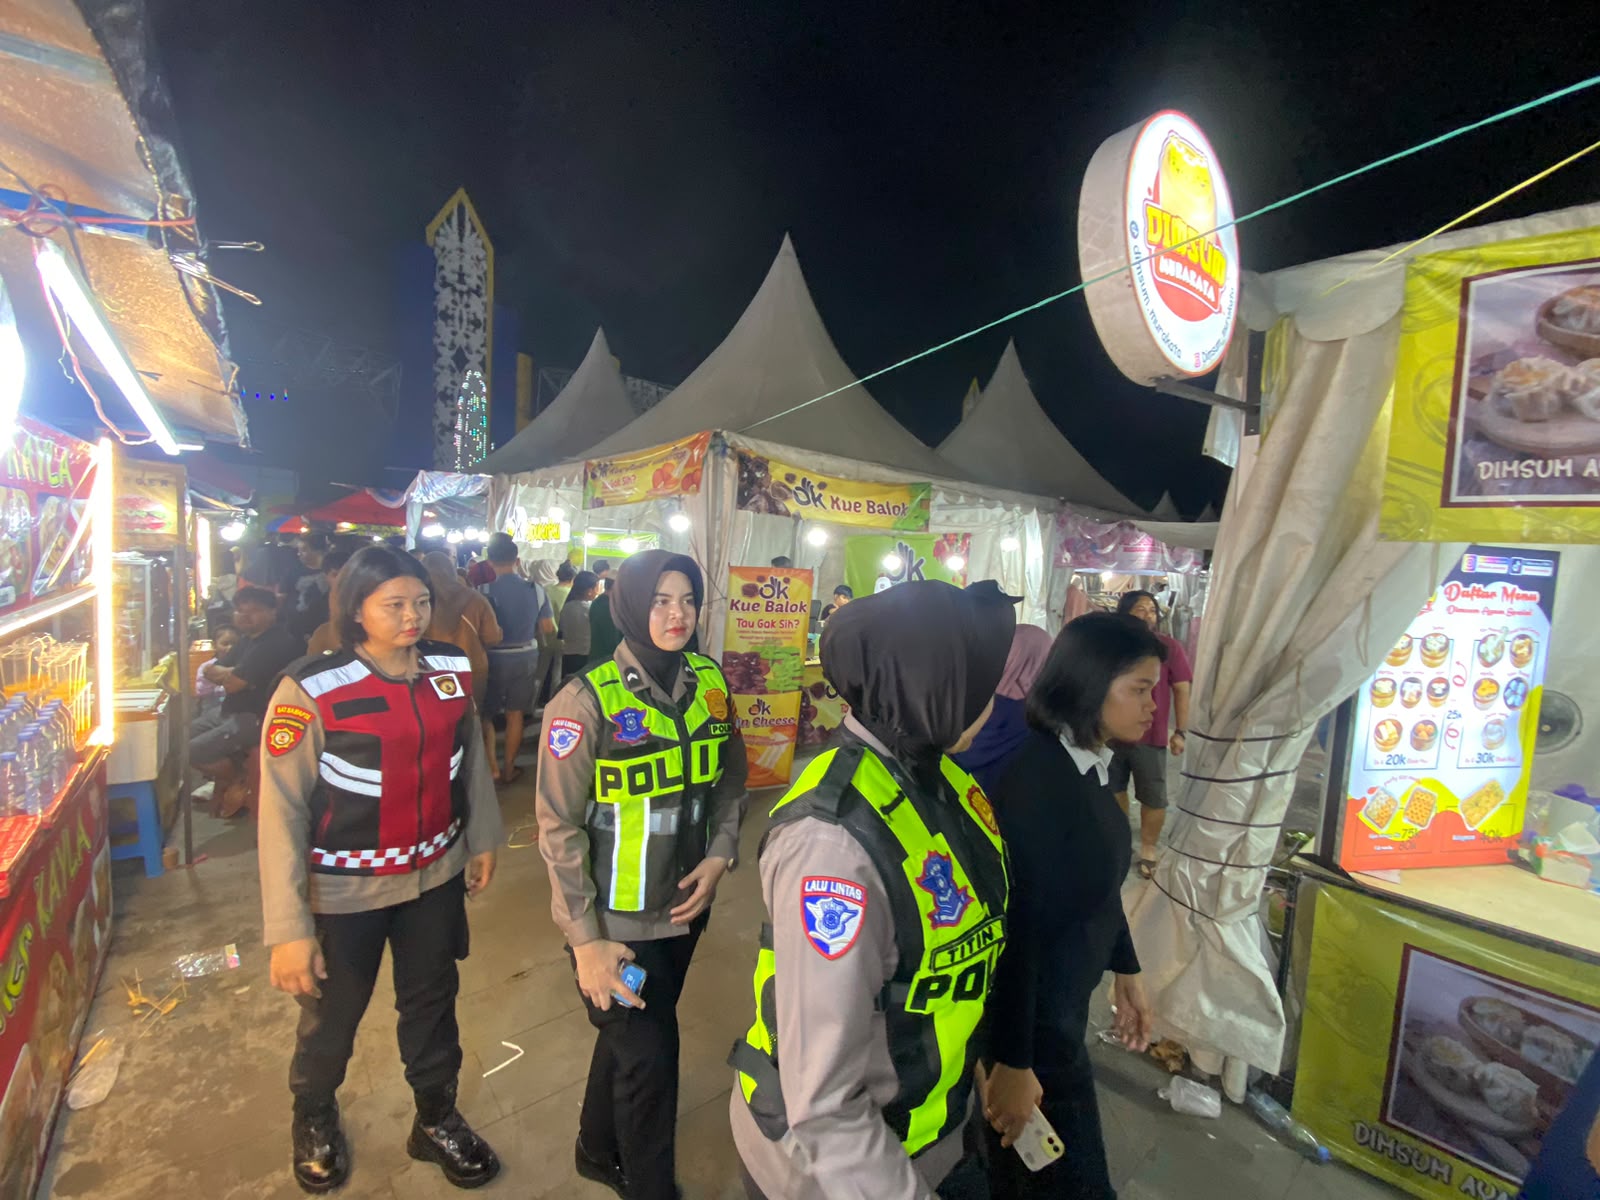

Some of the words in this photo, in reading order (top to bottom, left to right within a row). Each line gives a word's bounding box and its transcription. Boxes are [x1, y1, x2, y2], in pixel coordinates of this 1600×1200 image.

[1146, 205, 1227, 288] DIMSUM
[1478, 459, 1573, 479] DIMSUM
[1583, 458, 1600, 477] A
[830, 496, 861, 512] Kue
[866, 499, 908, 517] Balok
[1444, 583, 1497, 602] Daftar
[1501, 586, 1537, 604] Menu
[730, 599, 760, 612] Kue
[765, 600, 807, 613] Balok
[736, 618, 755, 628] Tau
[757, 618, 776, 629] Gak
[779, 619, 800, 629] Sih?
[1385, 754, 1406, 765] 20k
[1476, 752, 1495, 763] 30k
[805, 880, 829, 892] LALU
[830, 881, 862, 900] LINTAS
[947, 926, 994, 963] TITIN
[1354, 1121, 1453, 1185] DIMSUM
